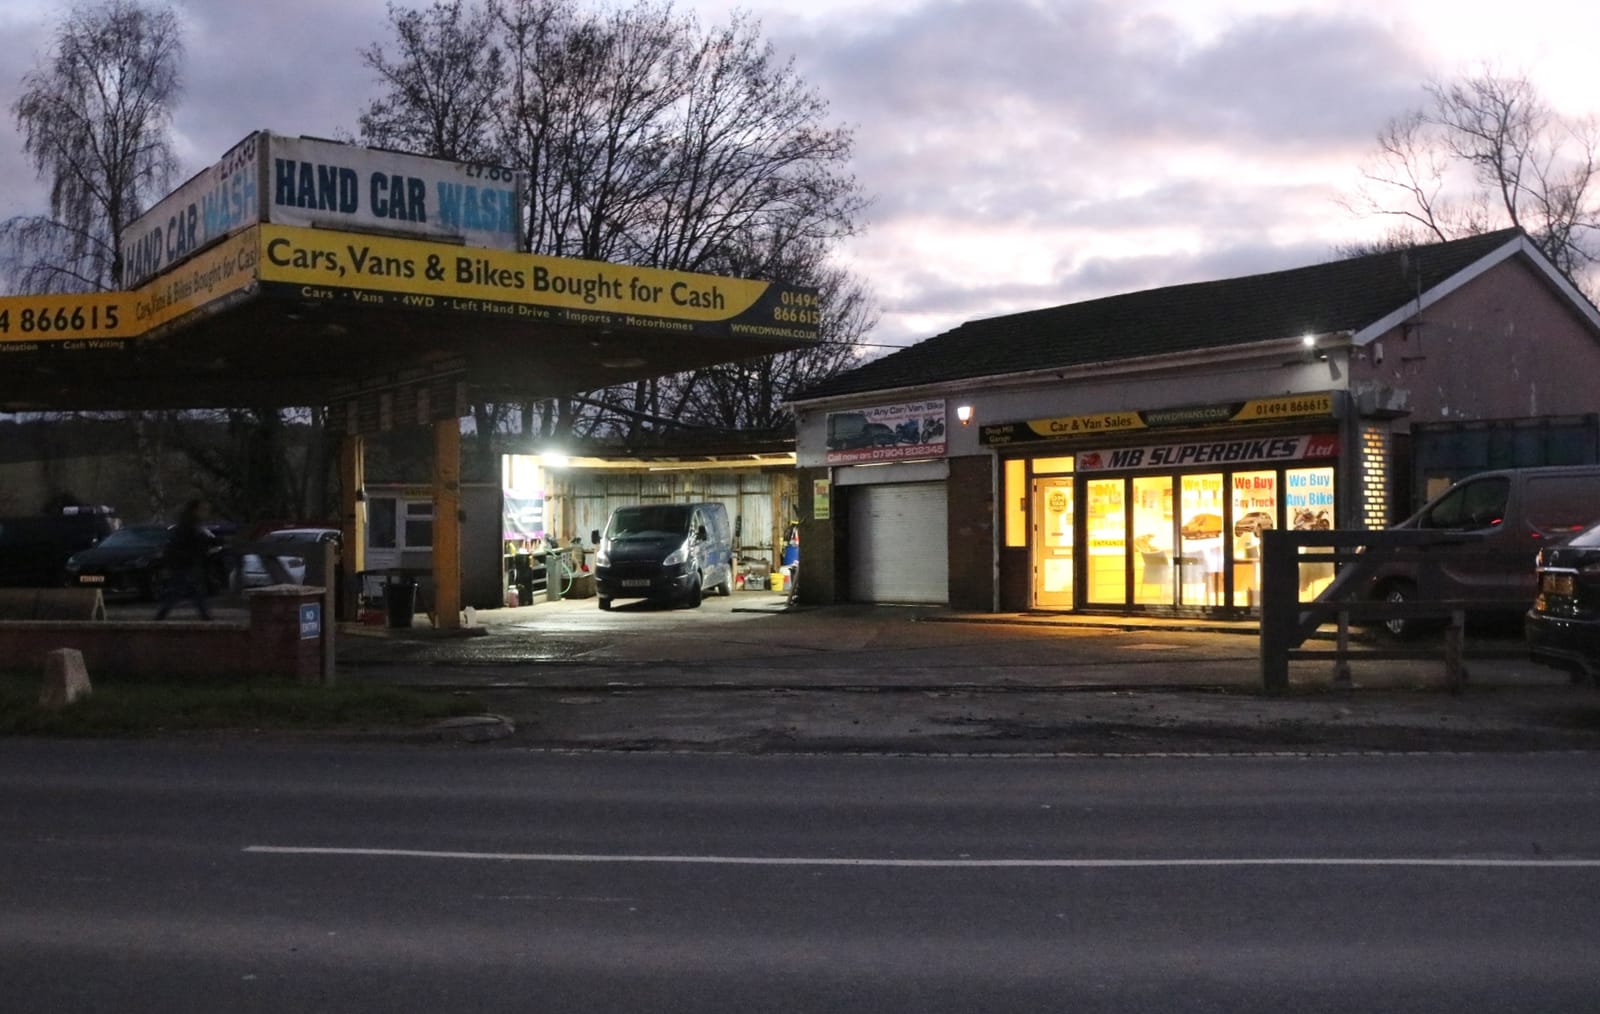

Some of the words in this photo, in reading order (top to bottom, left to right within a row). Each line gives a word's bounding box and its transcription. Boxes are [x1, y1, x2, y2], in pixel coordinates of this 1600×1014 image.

[274, 157, 359, 214] HAND
[370, 171, 427, 223] CAR
[437, 181, 517, 233] WASH
[126, 226, 163, 287] HAND
[166, 202, 198, 264] CAR
[202, 164, 257, 242] WASH
[193, 261, 221, 295] Bought
[222, 255, 237, 279] for
[424, 254, 446, 282] &
[456, 256, 526, 290] Bikes
[533, 265, 623, 305] Bought
[629, 276, 664, 303] for
[670, 281, 726, 311] Cash
[780, 289, 819, 308] 01494
[301, 286, 334, 300] Cars
[352, 290, 384, 304] Vans
[402, 296, 435, 308] 4WD
[452, 299, 478, 312] Left
[482, 302, 514, 316] Hand
[518, 305, 550, 319] Drive
[565, 310, 611, 325] Imports
[626, 316, 694, 331] Motorhomes
[20, 305, 119, 332] 866615
[0, 342, 39, 353] aluation
[874, 407, 889, 417] Any
[1255, 402, 1287, 415] 01494
[1290, 398, 1329, 413] 866615
[1049, 420, 1069, 433] Car
[1071, 419, 1080, 431] &
[1082, 417, 1102, 430] Van
[1104, 415, 1132, 429] Sales
[827, 453, 842, 463] Call
[904, 444, 945, 457] 202345
[1107, 449, 1143, 469] MB
[1146, 437, 1299, 466] SUPERBIKES
[1305, 441, 1335, 458] Ltd
[1183, 479, 1200, 491] We
[1201, 478, 1221, 492] Buy
[1234, 476, 1251, 490] We
[1253, 475, 1274, 491] Buy
[1289, 474, 1307, 488] We
[1309, 473, 1330, 487] Buy
[1250, 496, 1275, 508] Truck
[1286, 493, 1307, 507] Any
[1308, 492, 1334, 506] Bike
